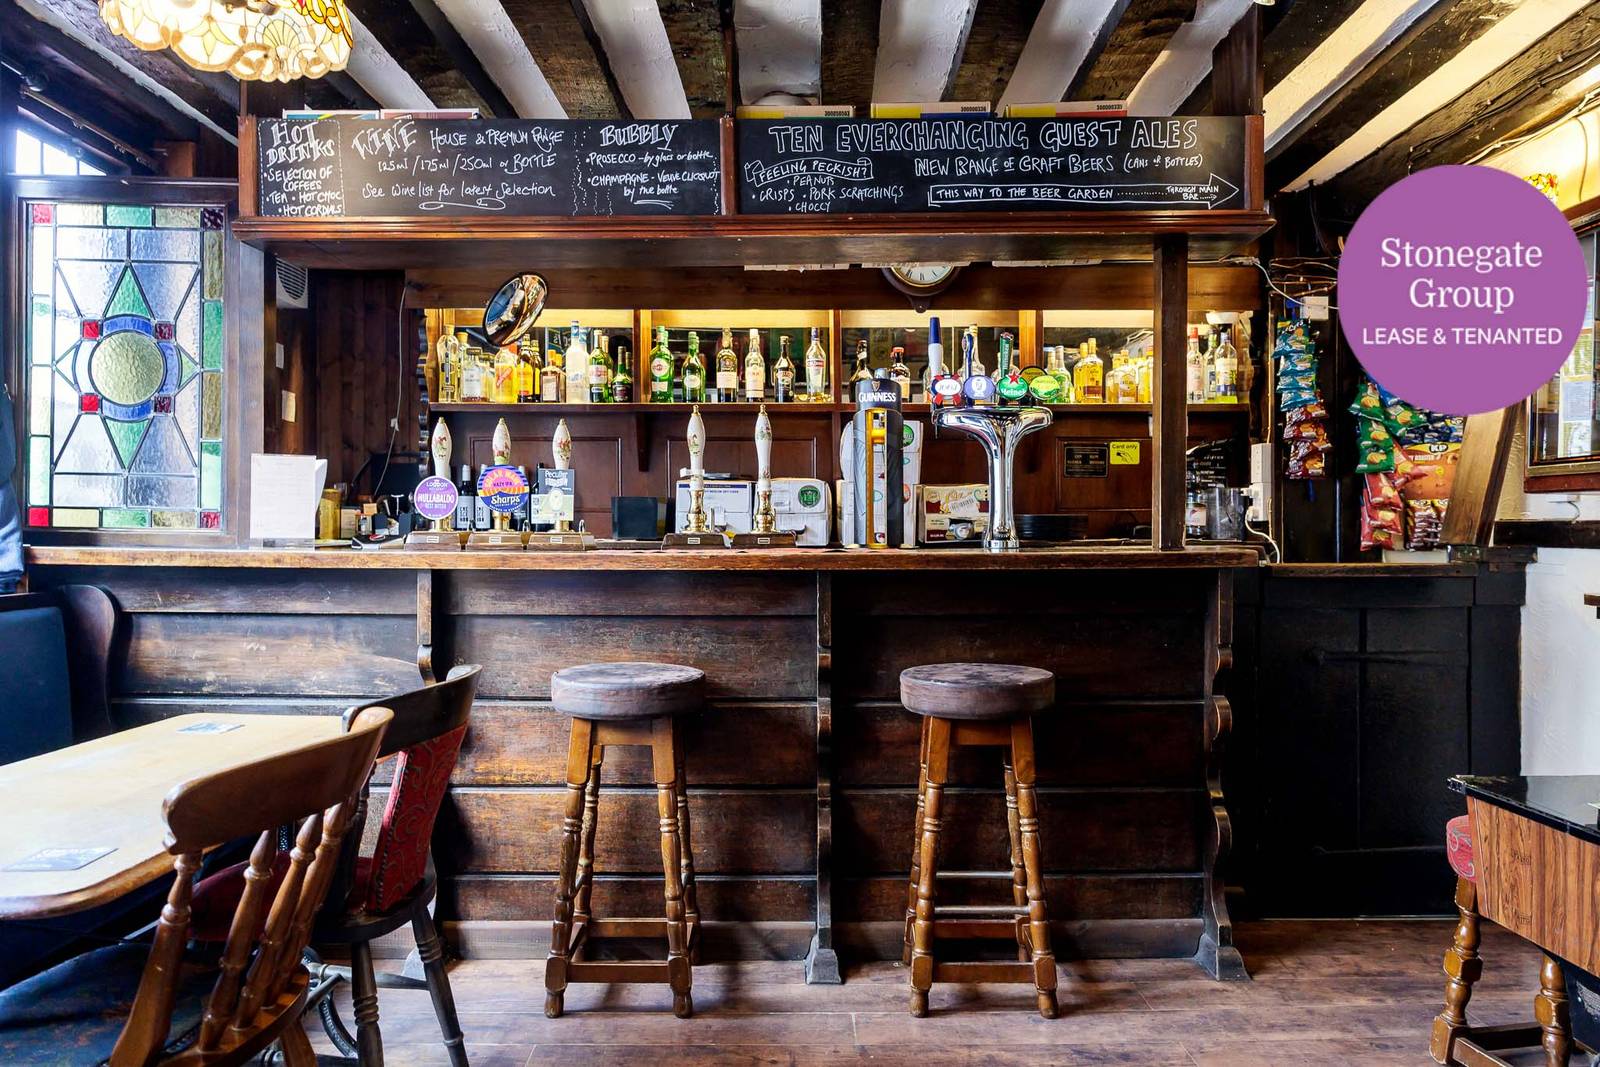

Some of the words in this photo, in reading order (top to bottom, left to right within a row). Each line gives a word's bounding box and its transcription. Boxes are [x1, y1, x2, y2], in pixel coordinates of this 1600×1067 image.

[271, 121, 318, 147] HOT
[352, 119, 417, 160] WINE
[430, 127, 467, 153] HOUSE
[475, 132, 485, 145] &
[486, 128, 528, 147] PREMIUM
[531, 126, 564, 152] RANGE
[600, 124, 678, 150] BUBBLY
[768, 125, 824, 153] TEN
[836, 120, 1028, 152] EVERCHANGING
[1040, 120, 1121, 152] GUEST
[1131, 119, 1198, 150] ALES
[266, 139, 335, 167] DRINKS
[589, 153, 636, 168] PROSECCO
[511, 153, 557, 174] BOTTLE
[759, 160, 807, 183] FEELING
[812, 159, 868, 180] PECKISH?
[915, 158, 950, 176] NEW
[955, 156, 998, 176] RANGE
[1069, 153, 1114, 173] BEERS
[1164, 153, 1203, 169] BOTTLES)
[268, 167, 317, 182] SELECTION
[320, 165, 333, 179] OF
[591, 173, 649, 187] CHAMPAGNE
[793, 174, 835, 187] PEANUTS
[283, 180, 322, 192] COFFEES
[362, 182, 386, 198] See
[418, 180, 433, 197] list
[437, 183, 455, 200] for
[461, 181, 492, 197] latest
[496, 182, 556, 199] Selection
[623, 186, 635, 200] by
[639, 185, 655, 195] the
[657, 184, 679, 195] bottle
[760, 187, 795, 201] CRISPS
[809, 187, 836, 200] PORK
[839, 185, 904, 203] SCRATCHINGS
[936, 188, 959, 199] THIS
[963, 188, 984, 199] WAY
[990, 188, 1002, 198] TO
[1007, 187, 1027, 198] THE
[1032, 187, 1061, 199] BEER
[1068, 188, 1113, 199] GARDEN
[1198, 185, 1219, 194] MAIN
[269, 191, 288, 203] TEA
[299, 191, 316, 203] HOT
[317, 190, 342, 202] CHOC
[283, 205, 304, 216] HOT
[795, 201, 831, 213] CHOCCY
[858, 391, 897, 403] GUINNESS
